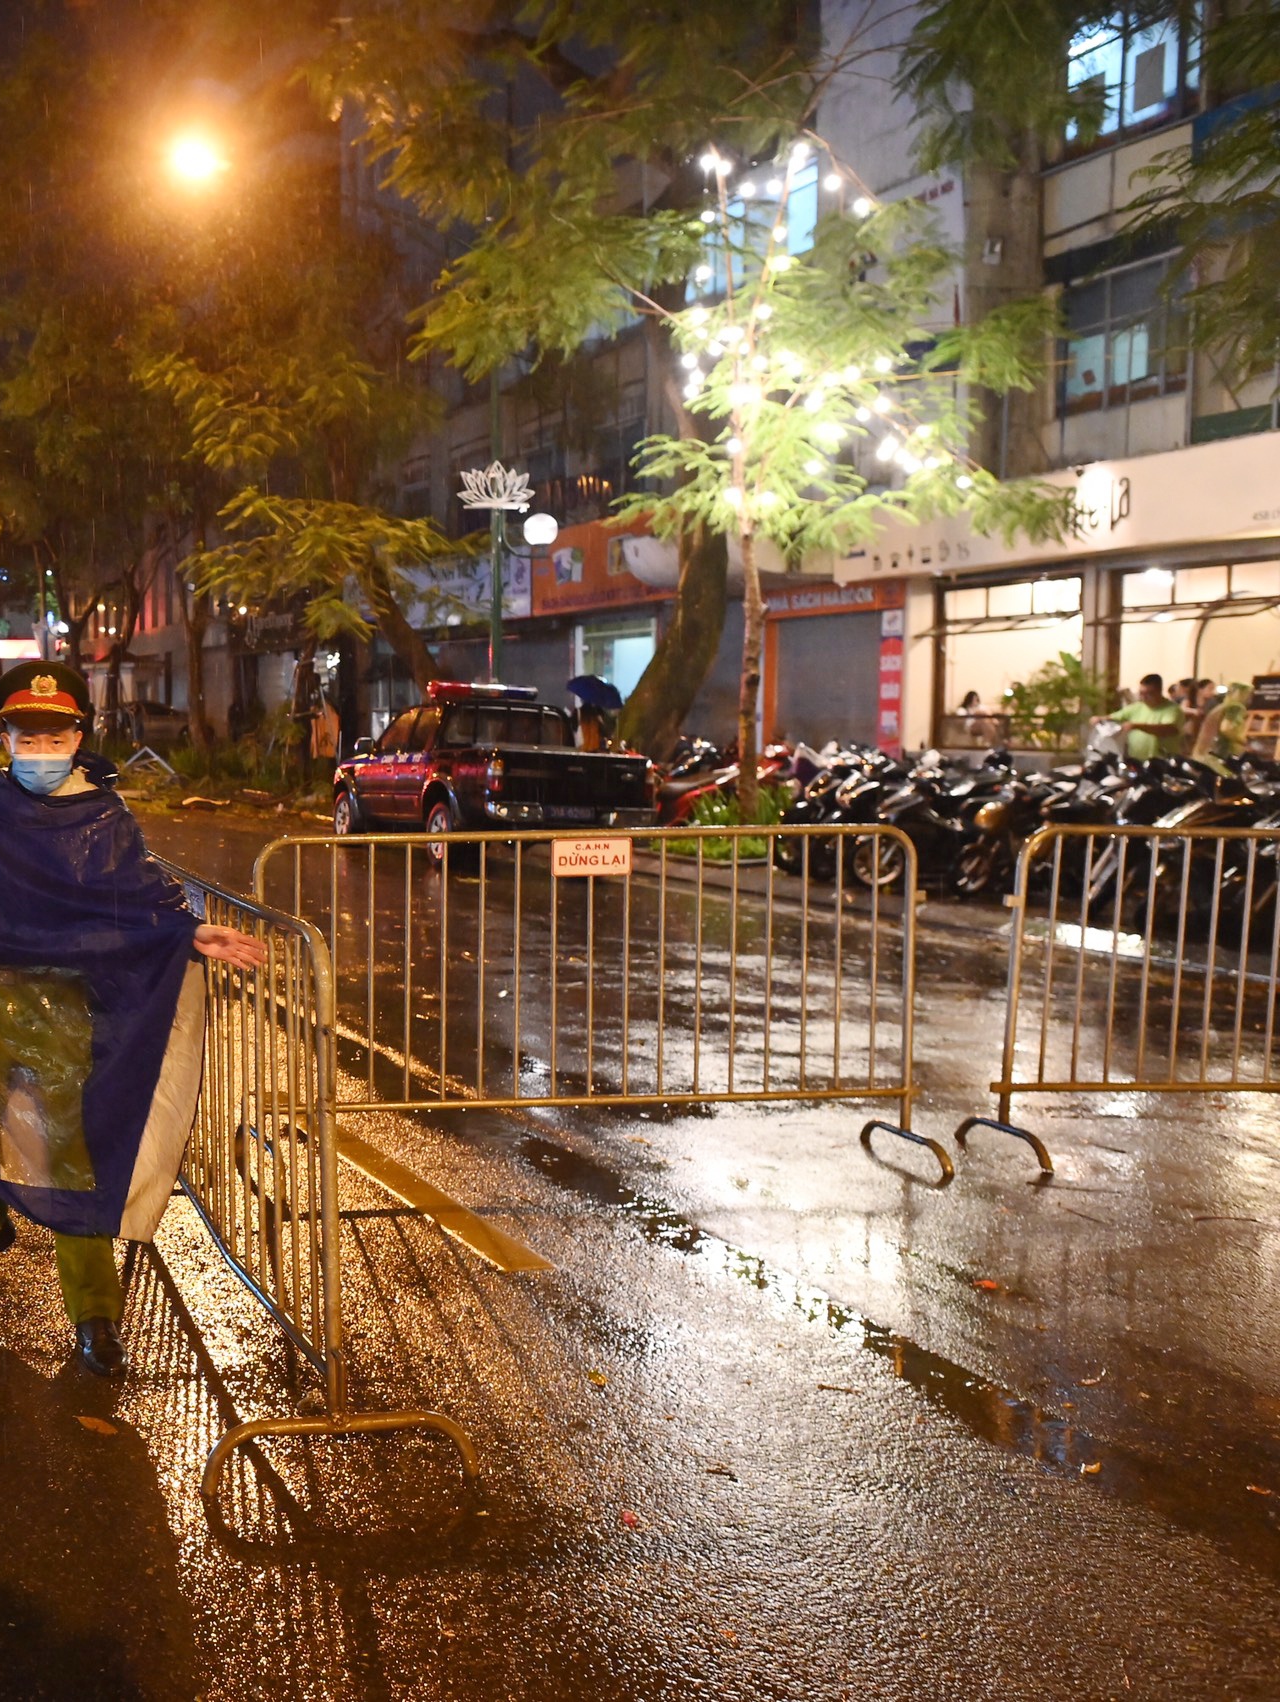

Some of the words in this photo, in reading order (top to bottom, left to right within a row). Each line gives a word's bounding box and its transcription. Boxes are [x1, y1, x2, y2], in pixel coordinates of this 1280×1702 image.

[575, 843, 610, 851] C.A.H.N
[558, 851, 599, 867] DỪNG
[602, 854, 626, 868] LẠI
